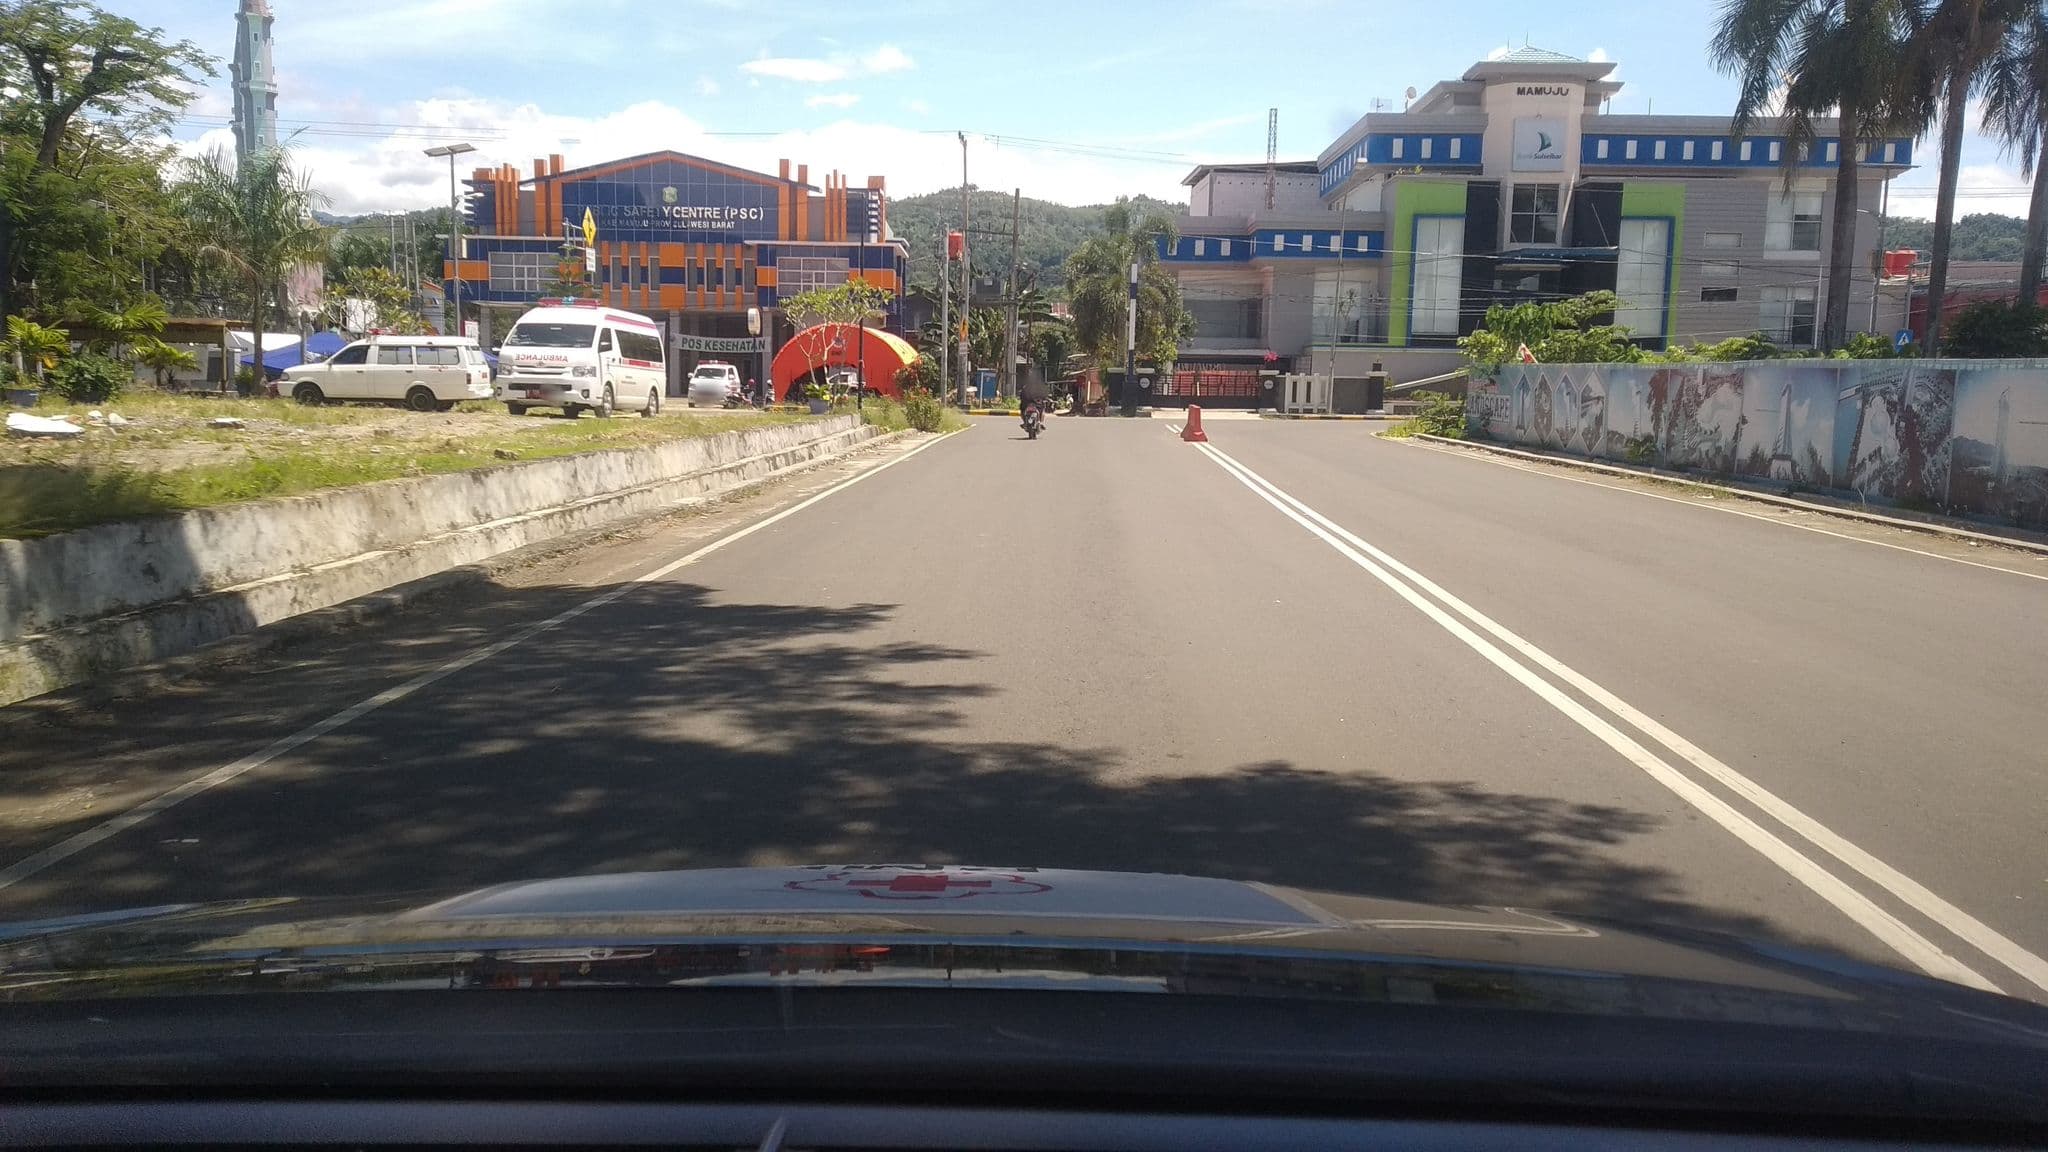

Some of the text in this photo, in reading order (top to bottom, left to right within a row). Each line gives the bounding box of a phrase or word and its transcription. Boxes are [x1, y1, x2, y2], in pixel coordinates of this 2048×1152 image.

[1517, 86, 1569, 97] MAMUJU
[578, 205, 764, 221] PBLIC SAFETY CENTRE (PSC)
[711, 221, 735, 229] BARAT
[681, 337, 766, 352] POS KESEHATAN
[1467, 394, 1510, 420] ANDSCAPE
